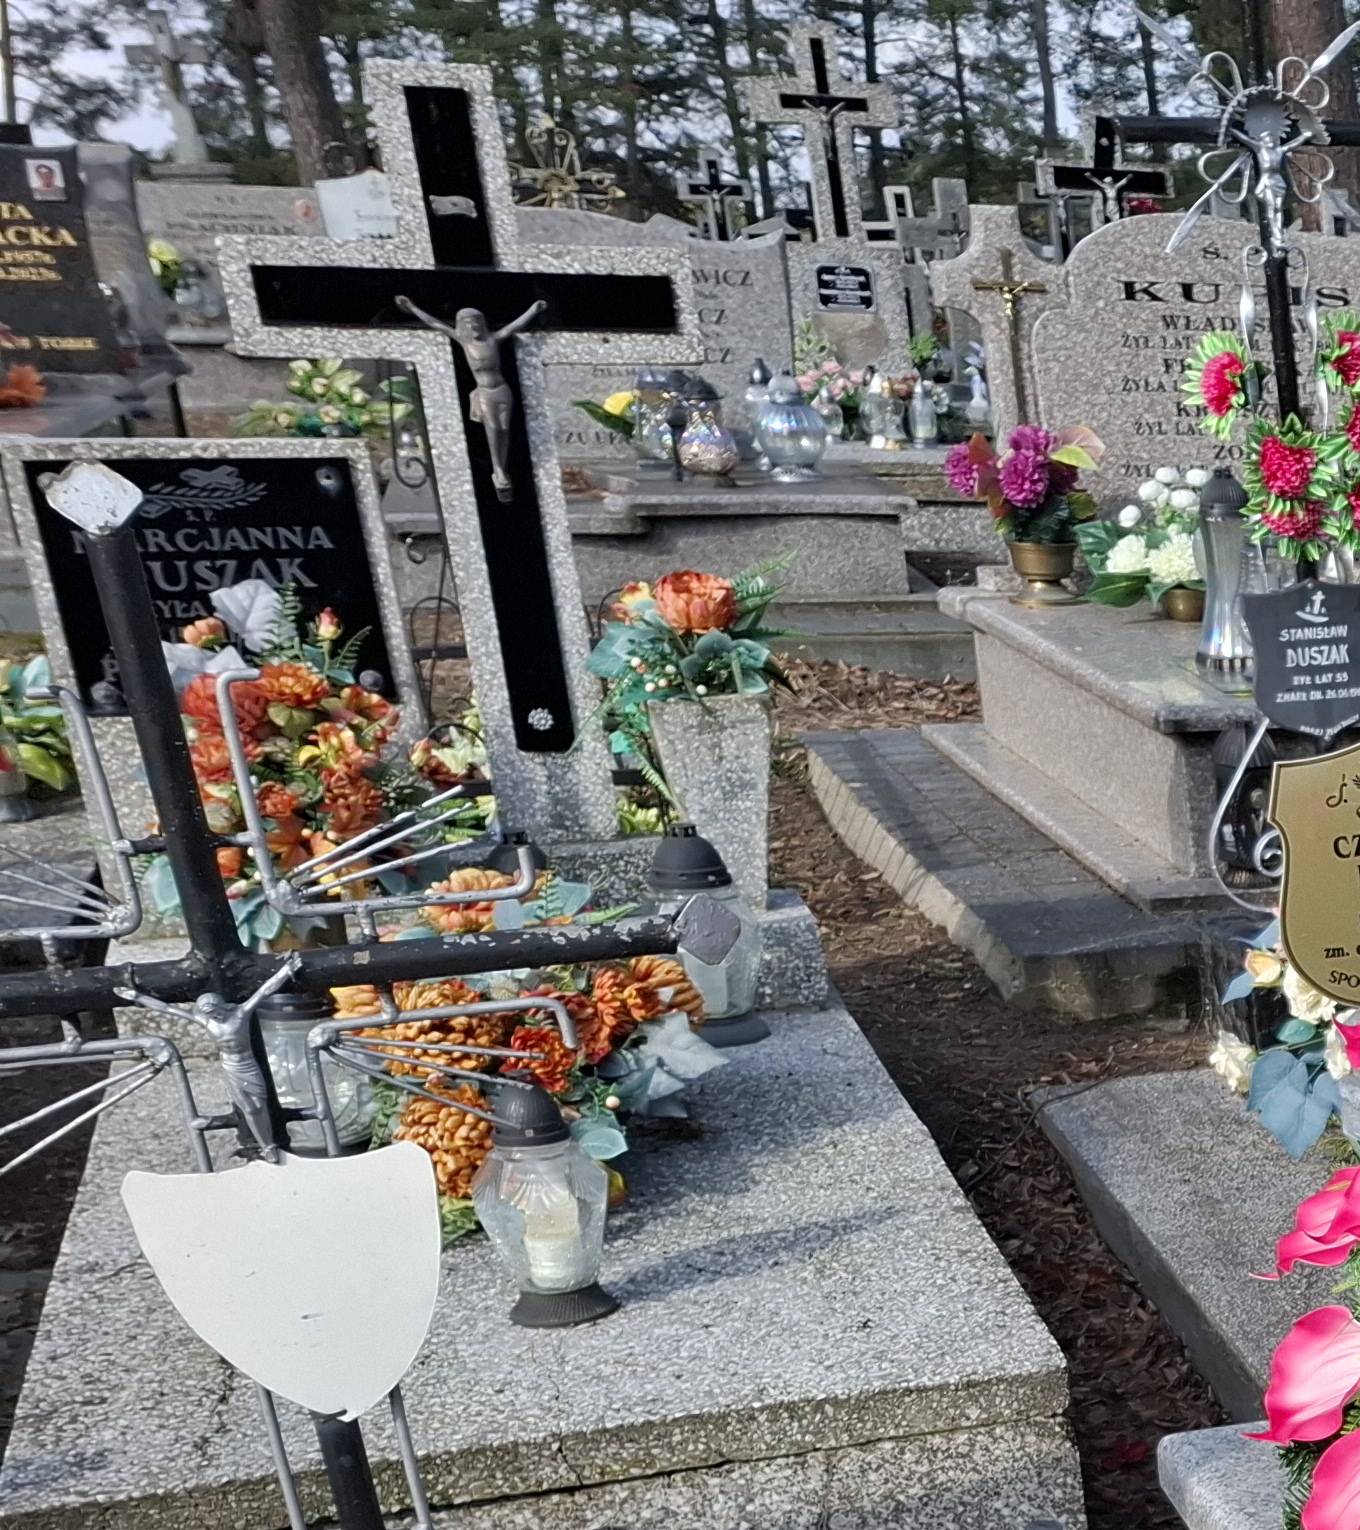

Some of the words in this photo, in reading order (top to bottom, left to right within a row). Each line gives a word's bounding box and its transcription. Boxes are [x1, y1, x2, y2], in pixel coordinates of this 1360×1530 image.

[70, 525, 336, 554] RCJANNA
[145, 556, 319, 592] USZAK
[1278, 624, 1349, 642] STANISŁAW
[1285, 644, 1350, 668] DUSZAK
[1315, 673, 1334, 684] LAT
[1324, 946, 1350, 959] zm.
